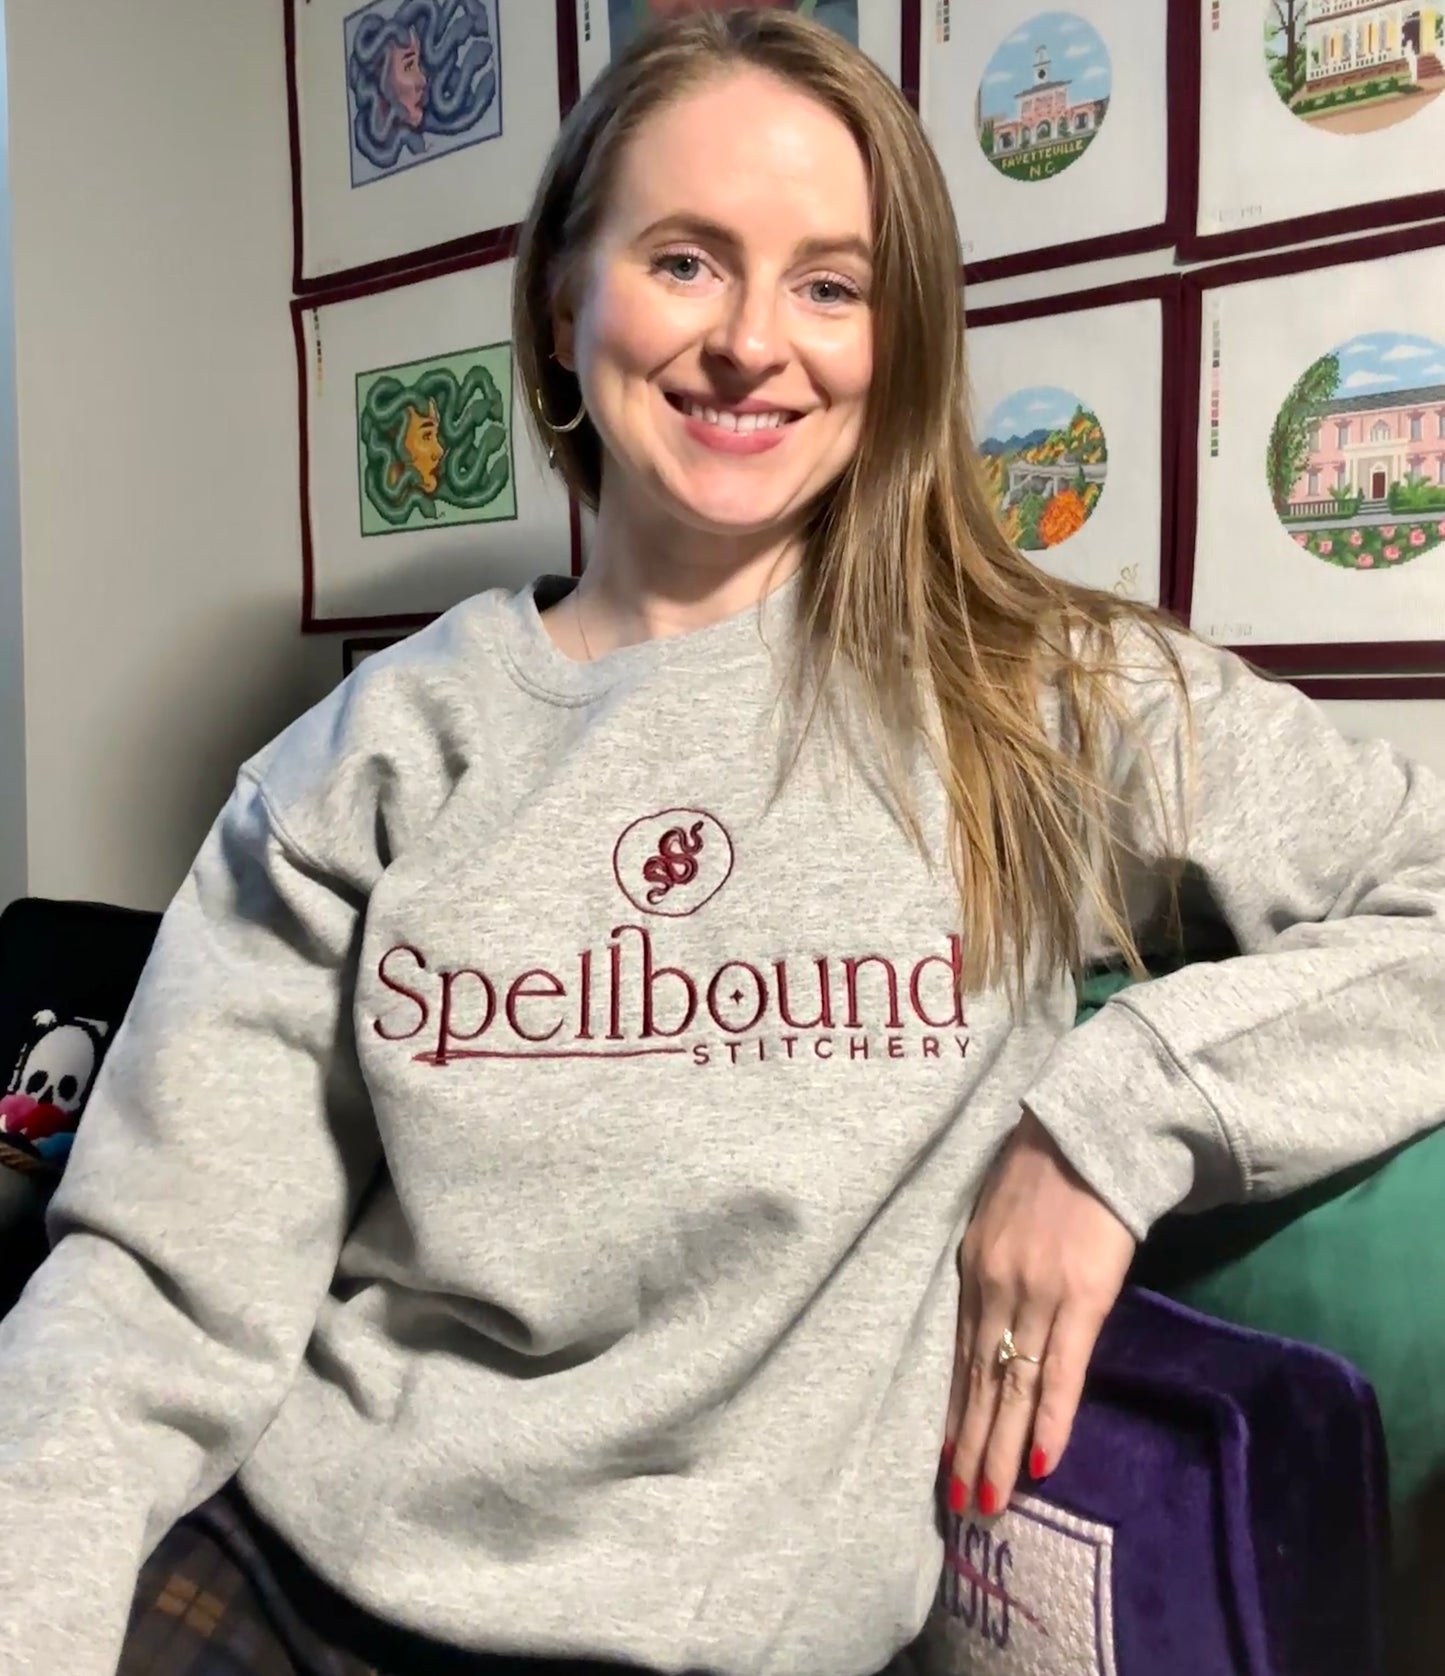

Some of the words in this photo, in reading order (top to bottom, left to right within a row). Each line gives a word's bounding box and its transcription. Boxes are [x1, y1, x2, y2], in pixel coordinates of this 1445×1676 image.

[374, 924, 968, 1066] Spellbound
[692, 1036, 971, 1065] STITCHERY
[941, 1514, 1013, 1649] ISIS
